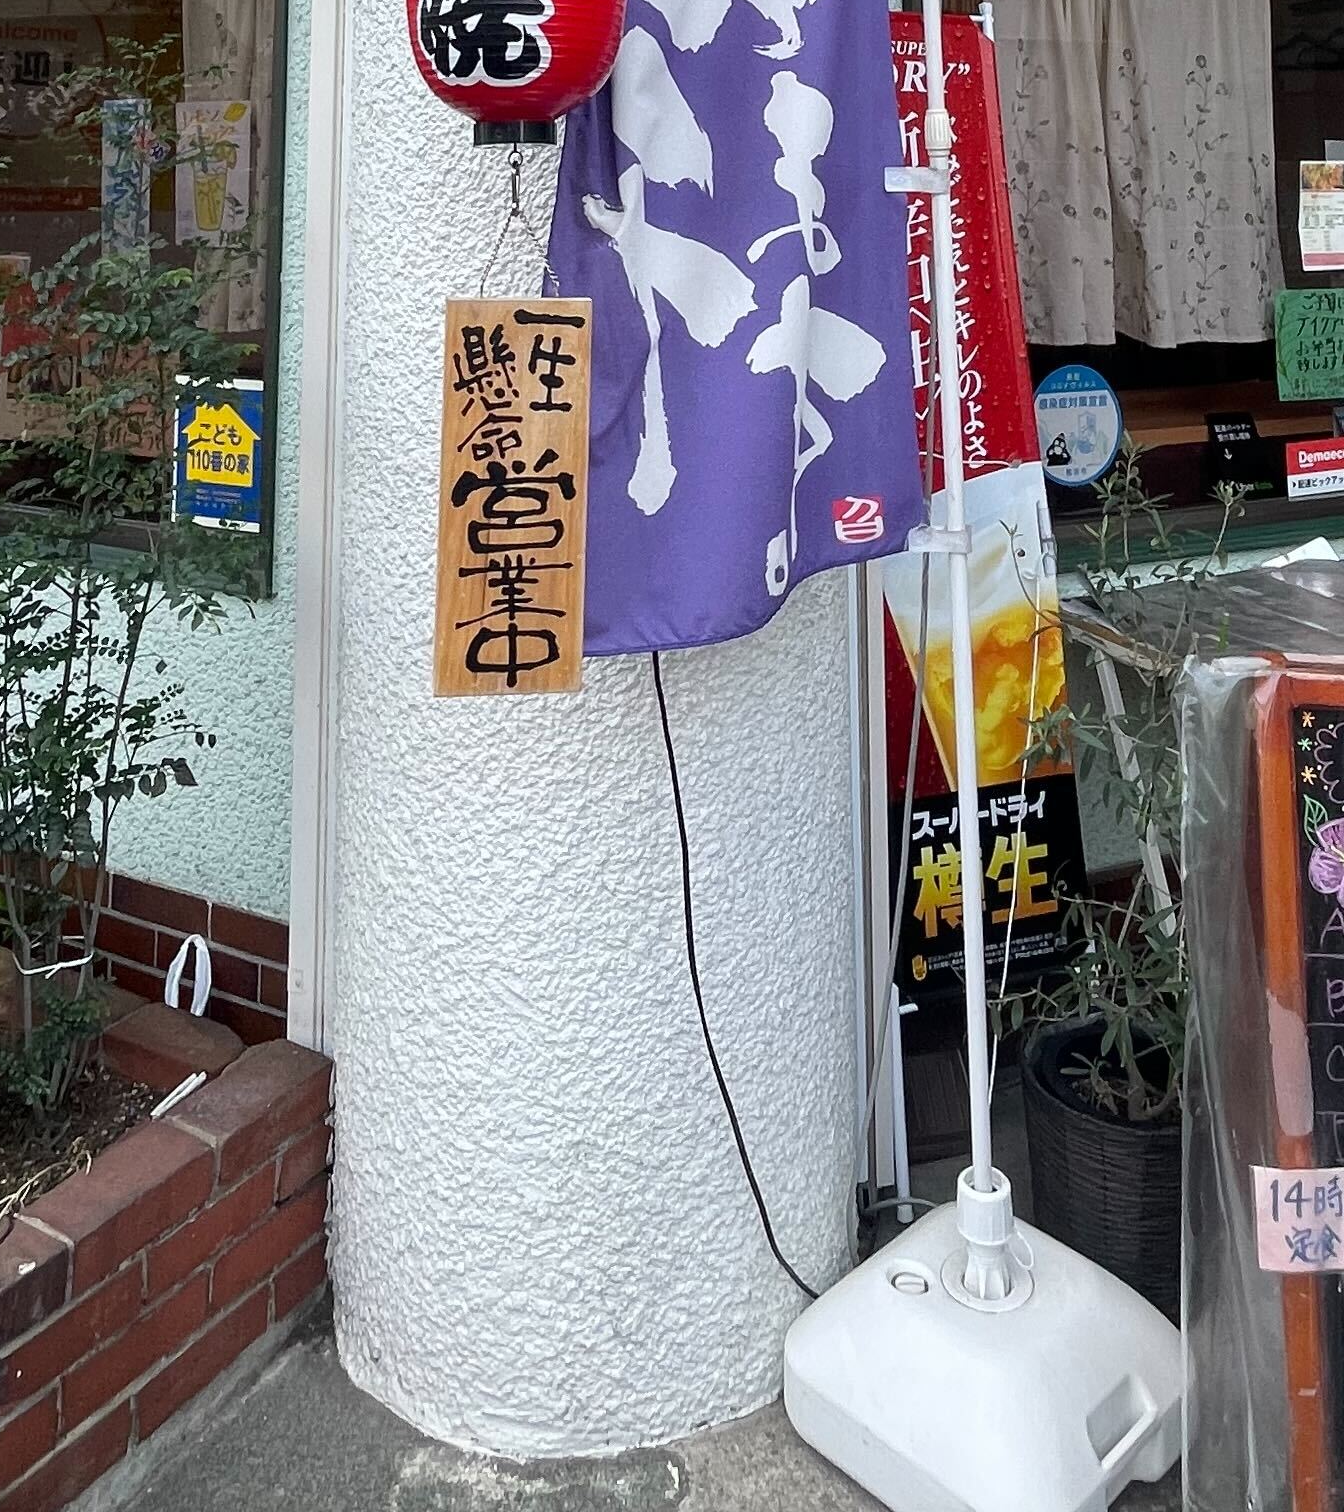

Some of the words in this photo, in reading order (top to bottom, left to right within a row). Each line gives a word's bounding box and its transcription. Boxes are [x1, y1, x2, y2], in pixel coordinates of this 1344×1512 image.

[452, 323, 524, 461] 懸命
[513, 308, 586, 412] 一生
[188, 448, 250, 475] 110番の家
[199, 423, 242, 446] こども
[450, 448, 578, 688] 営業中
